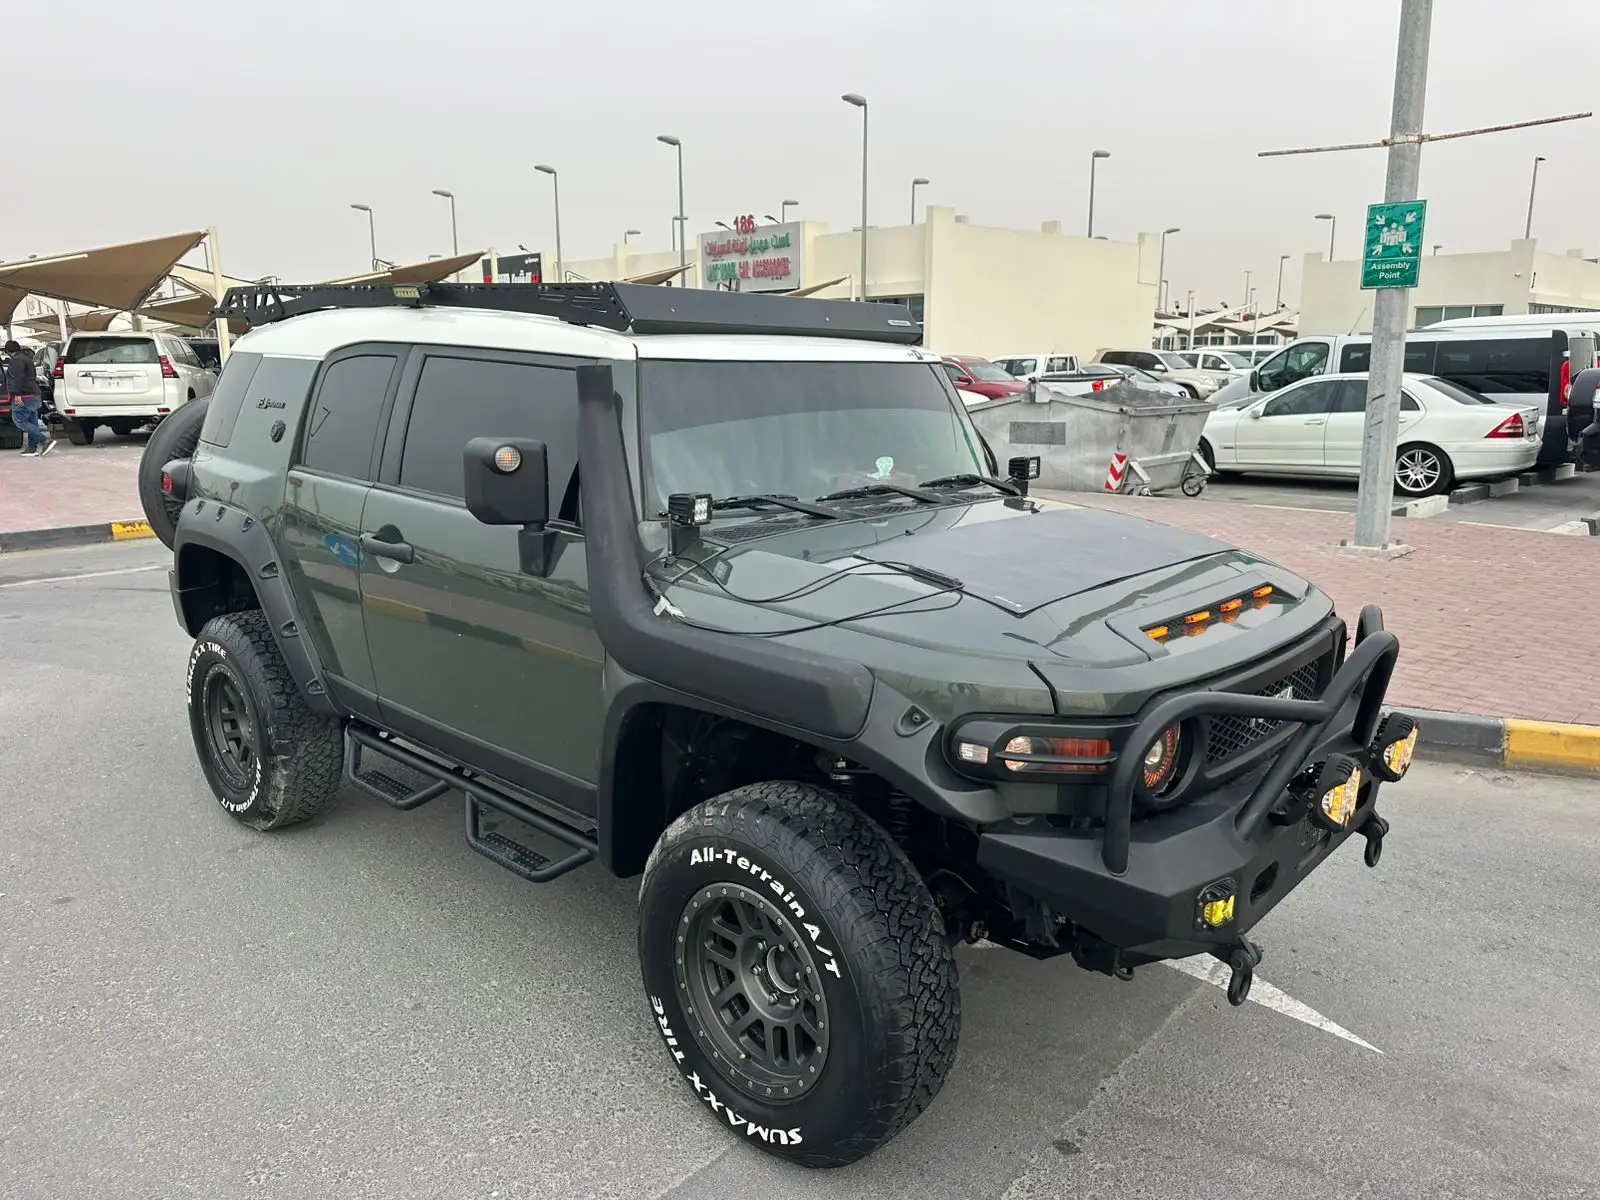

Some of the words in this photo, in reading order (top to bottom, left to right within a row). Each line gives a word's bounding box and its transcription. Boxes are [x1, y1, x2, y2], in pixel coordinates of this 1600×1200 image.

[733, 214, 757, 235] 186
[1371, 262, 1410, 270] Assembly
[206, 641, 227, 660] TIRE
[220, 797, 236, 812] A/T
[690, 847, 805, 918] All-Terrain
[802, 921, 841, 978] A/T
[651, 995, 685, 1064] TIRE
[687, 1070, 803, 1145] SUMAXX
